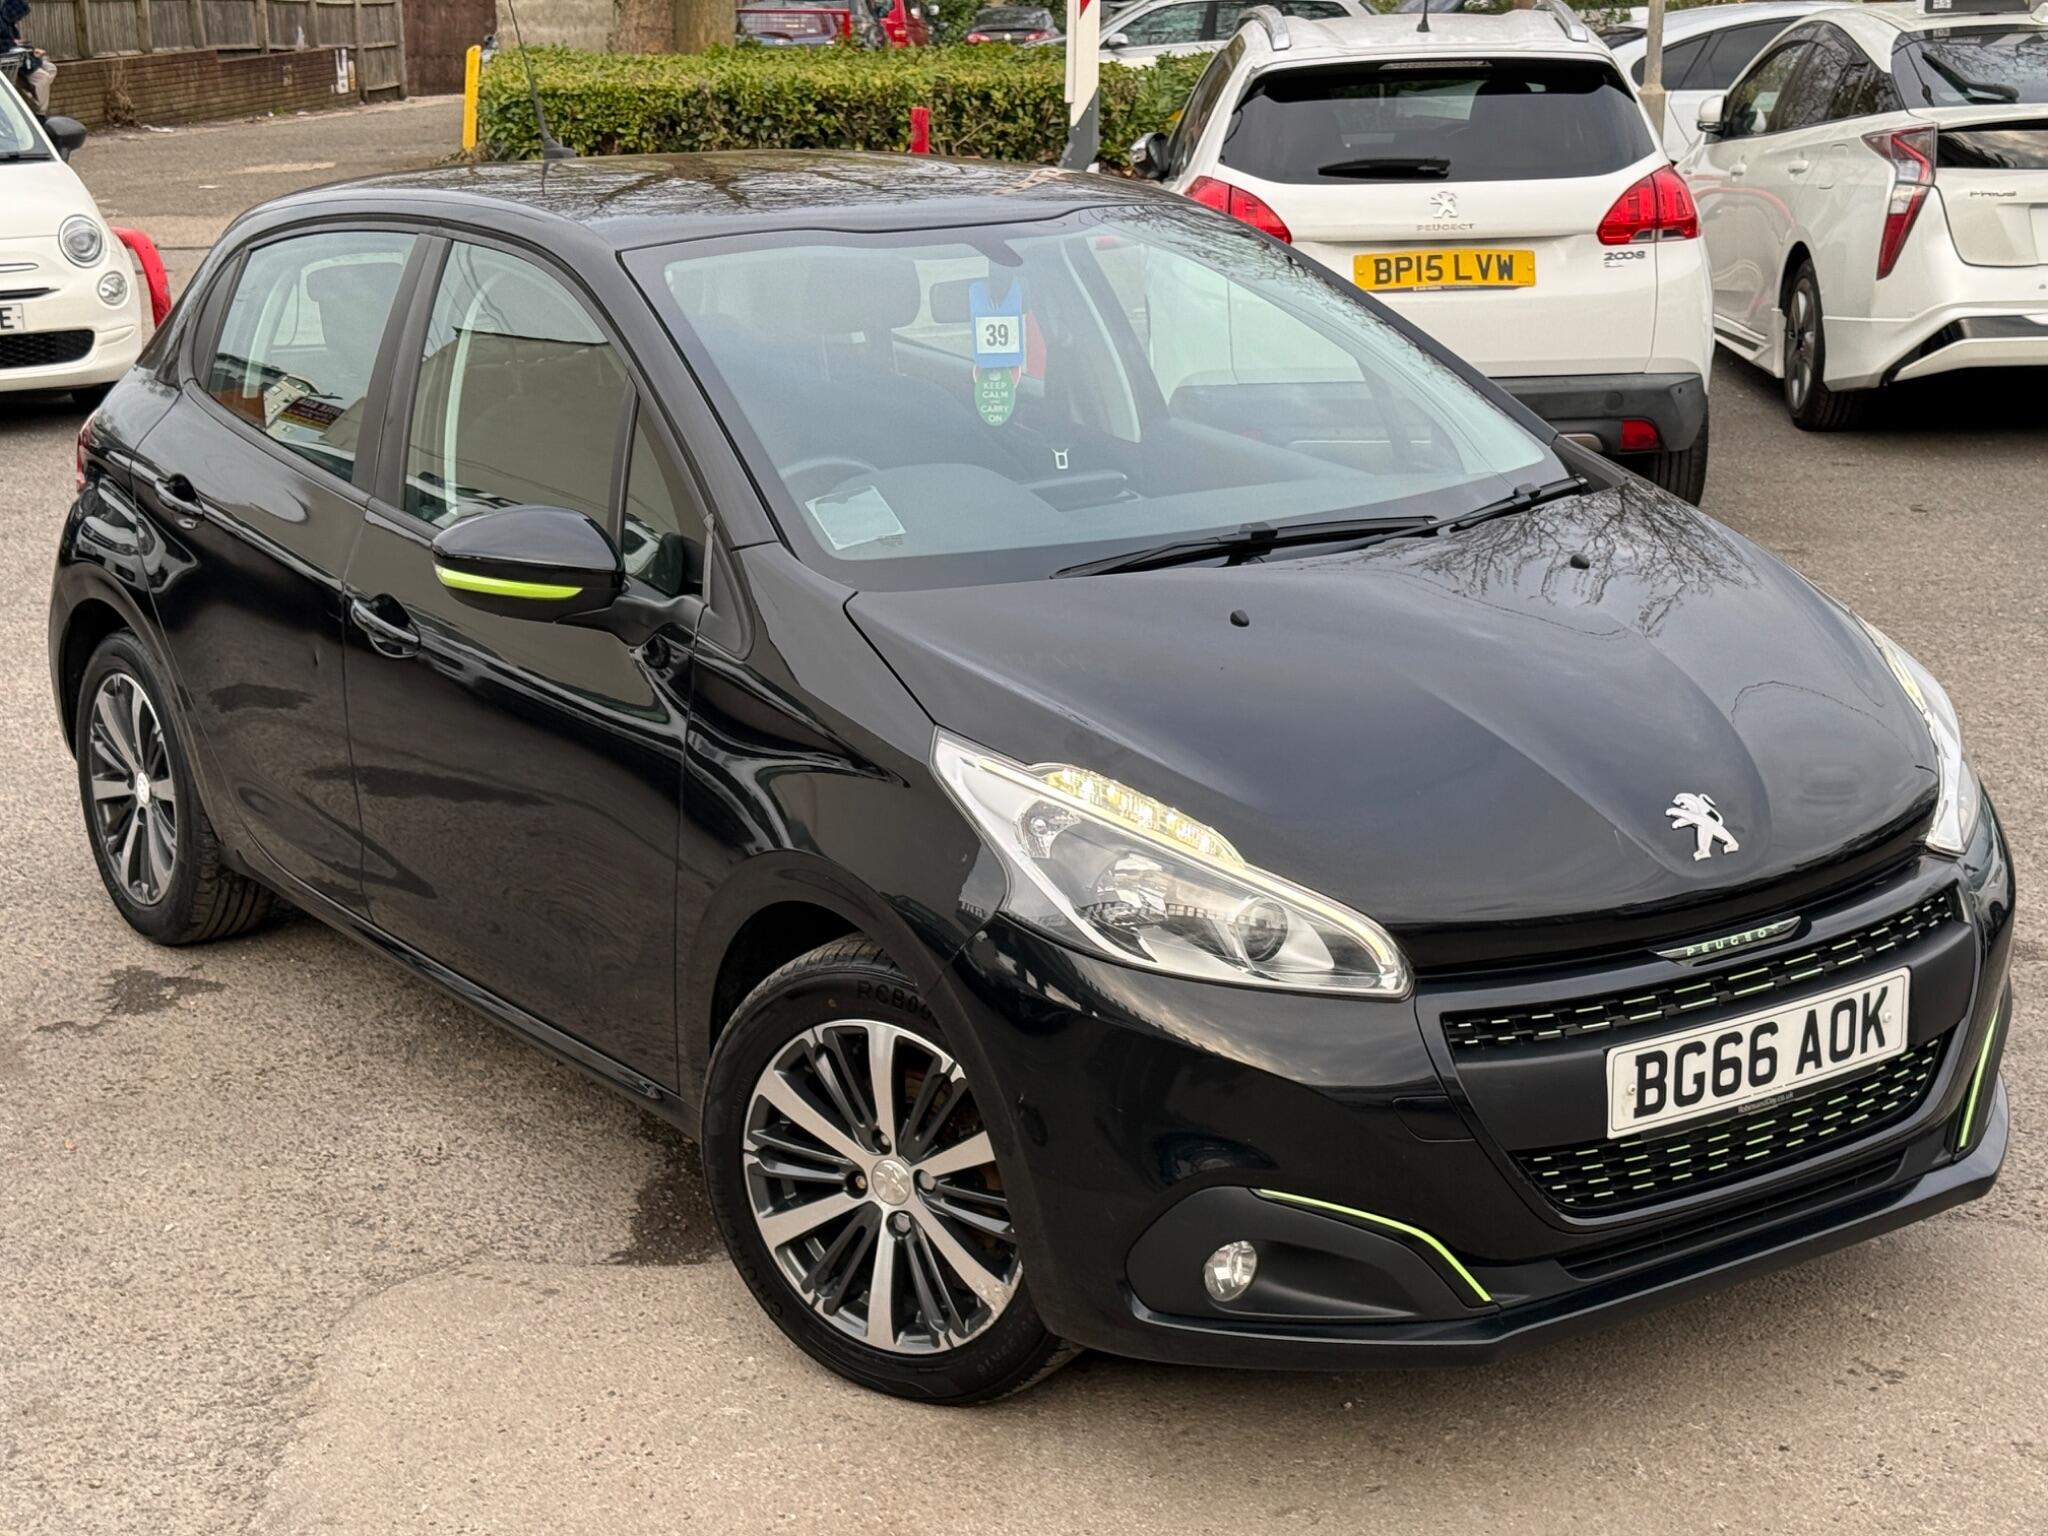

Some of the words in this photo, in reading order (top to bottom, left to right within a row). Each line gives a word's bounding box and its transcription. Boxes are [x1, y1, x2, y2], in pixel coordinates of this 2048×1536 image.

[1416, 223, 1475, 232] PEUGEOT
[1603, 250, 1646, 261] 2008
[1373, 254, 1444, 285] BP15
[1453, 254, 1514, 281] LVW
[985, 323, 1009, 347] 39
[983, 382, 1008, 390] KEEP
[982, 390, 1009, 399] CALM
[980, 405, 1010, 413] CARRY
[1633, 1021, 1779, 1119] BG66
[1795, 985, 1888, 1076] AOK
